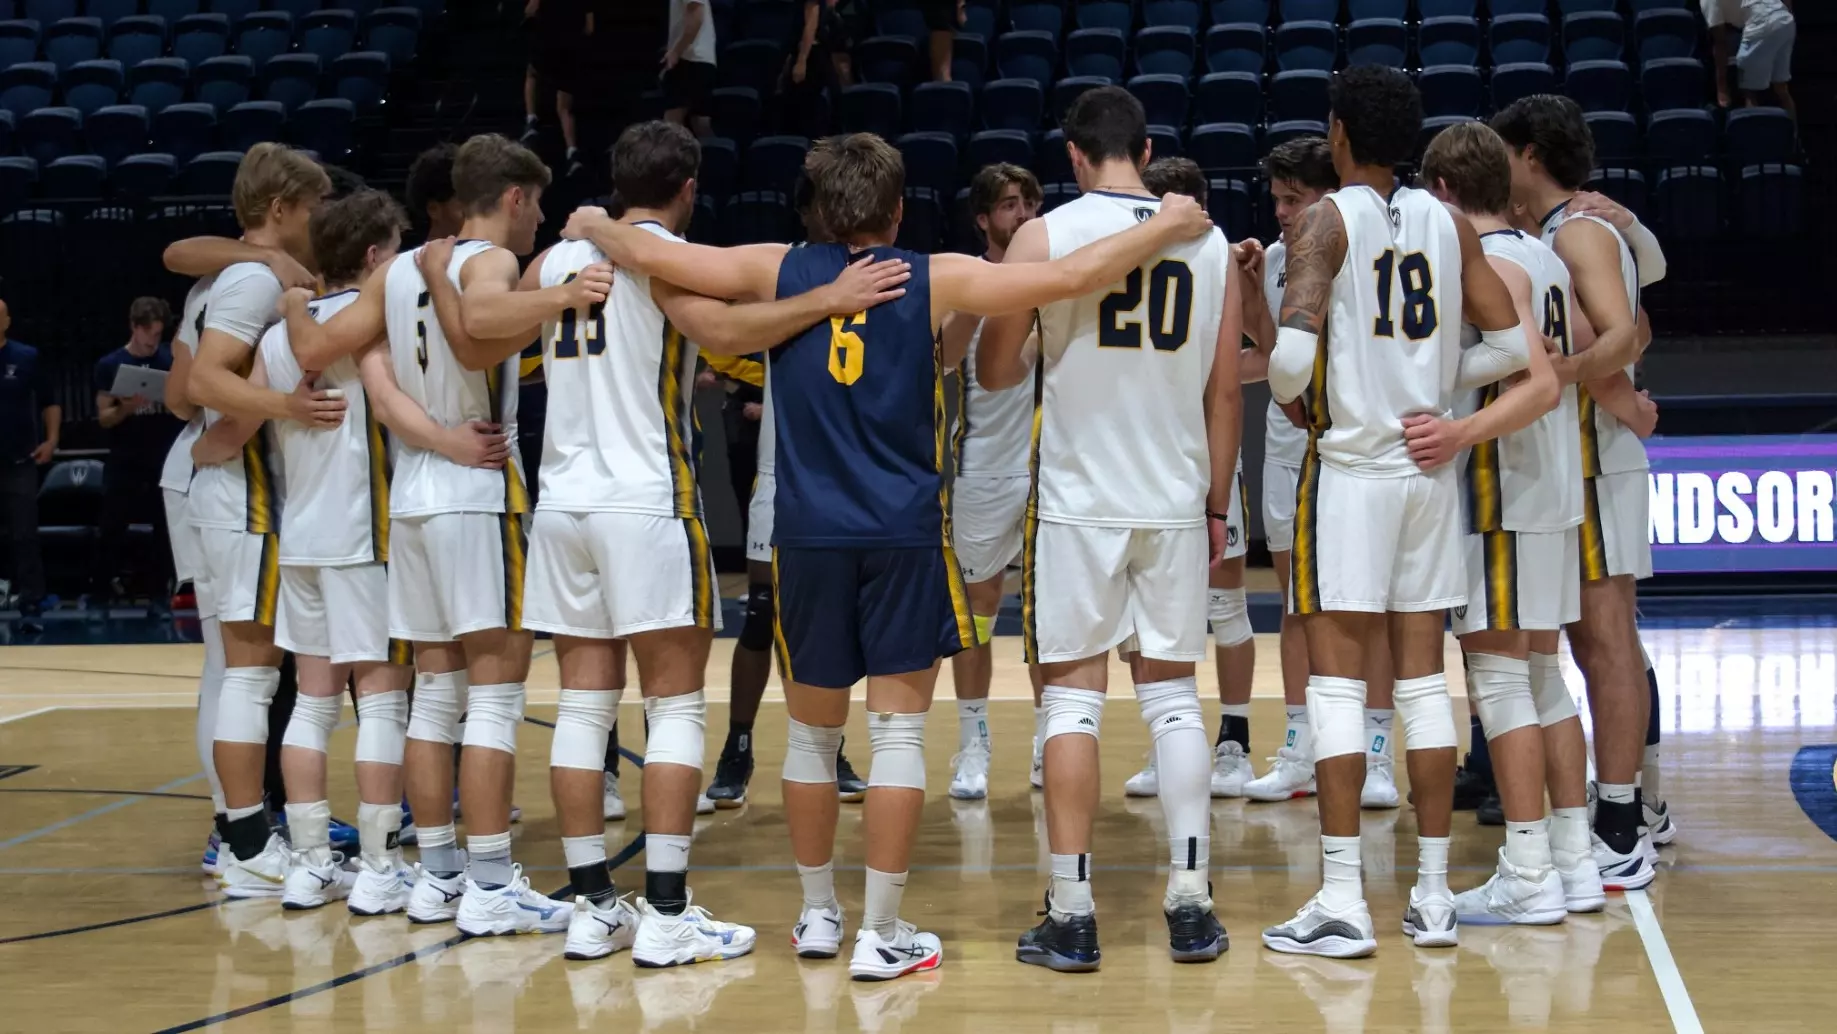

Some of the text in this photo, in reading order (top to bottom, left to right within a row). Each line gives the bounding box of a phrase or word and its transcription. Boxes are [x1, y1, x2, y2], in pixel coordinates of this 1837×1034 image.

[1097, 257, 1195, 353] 20
[1372, 247, 1439, 342] 18
[828, 302, 867, 386] 6
